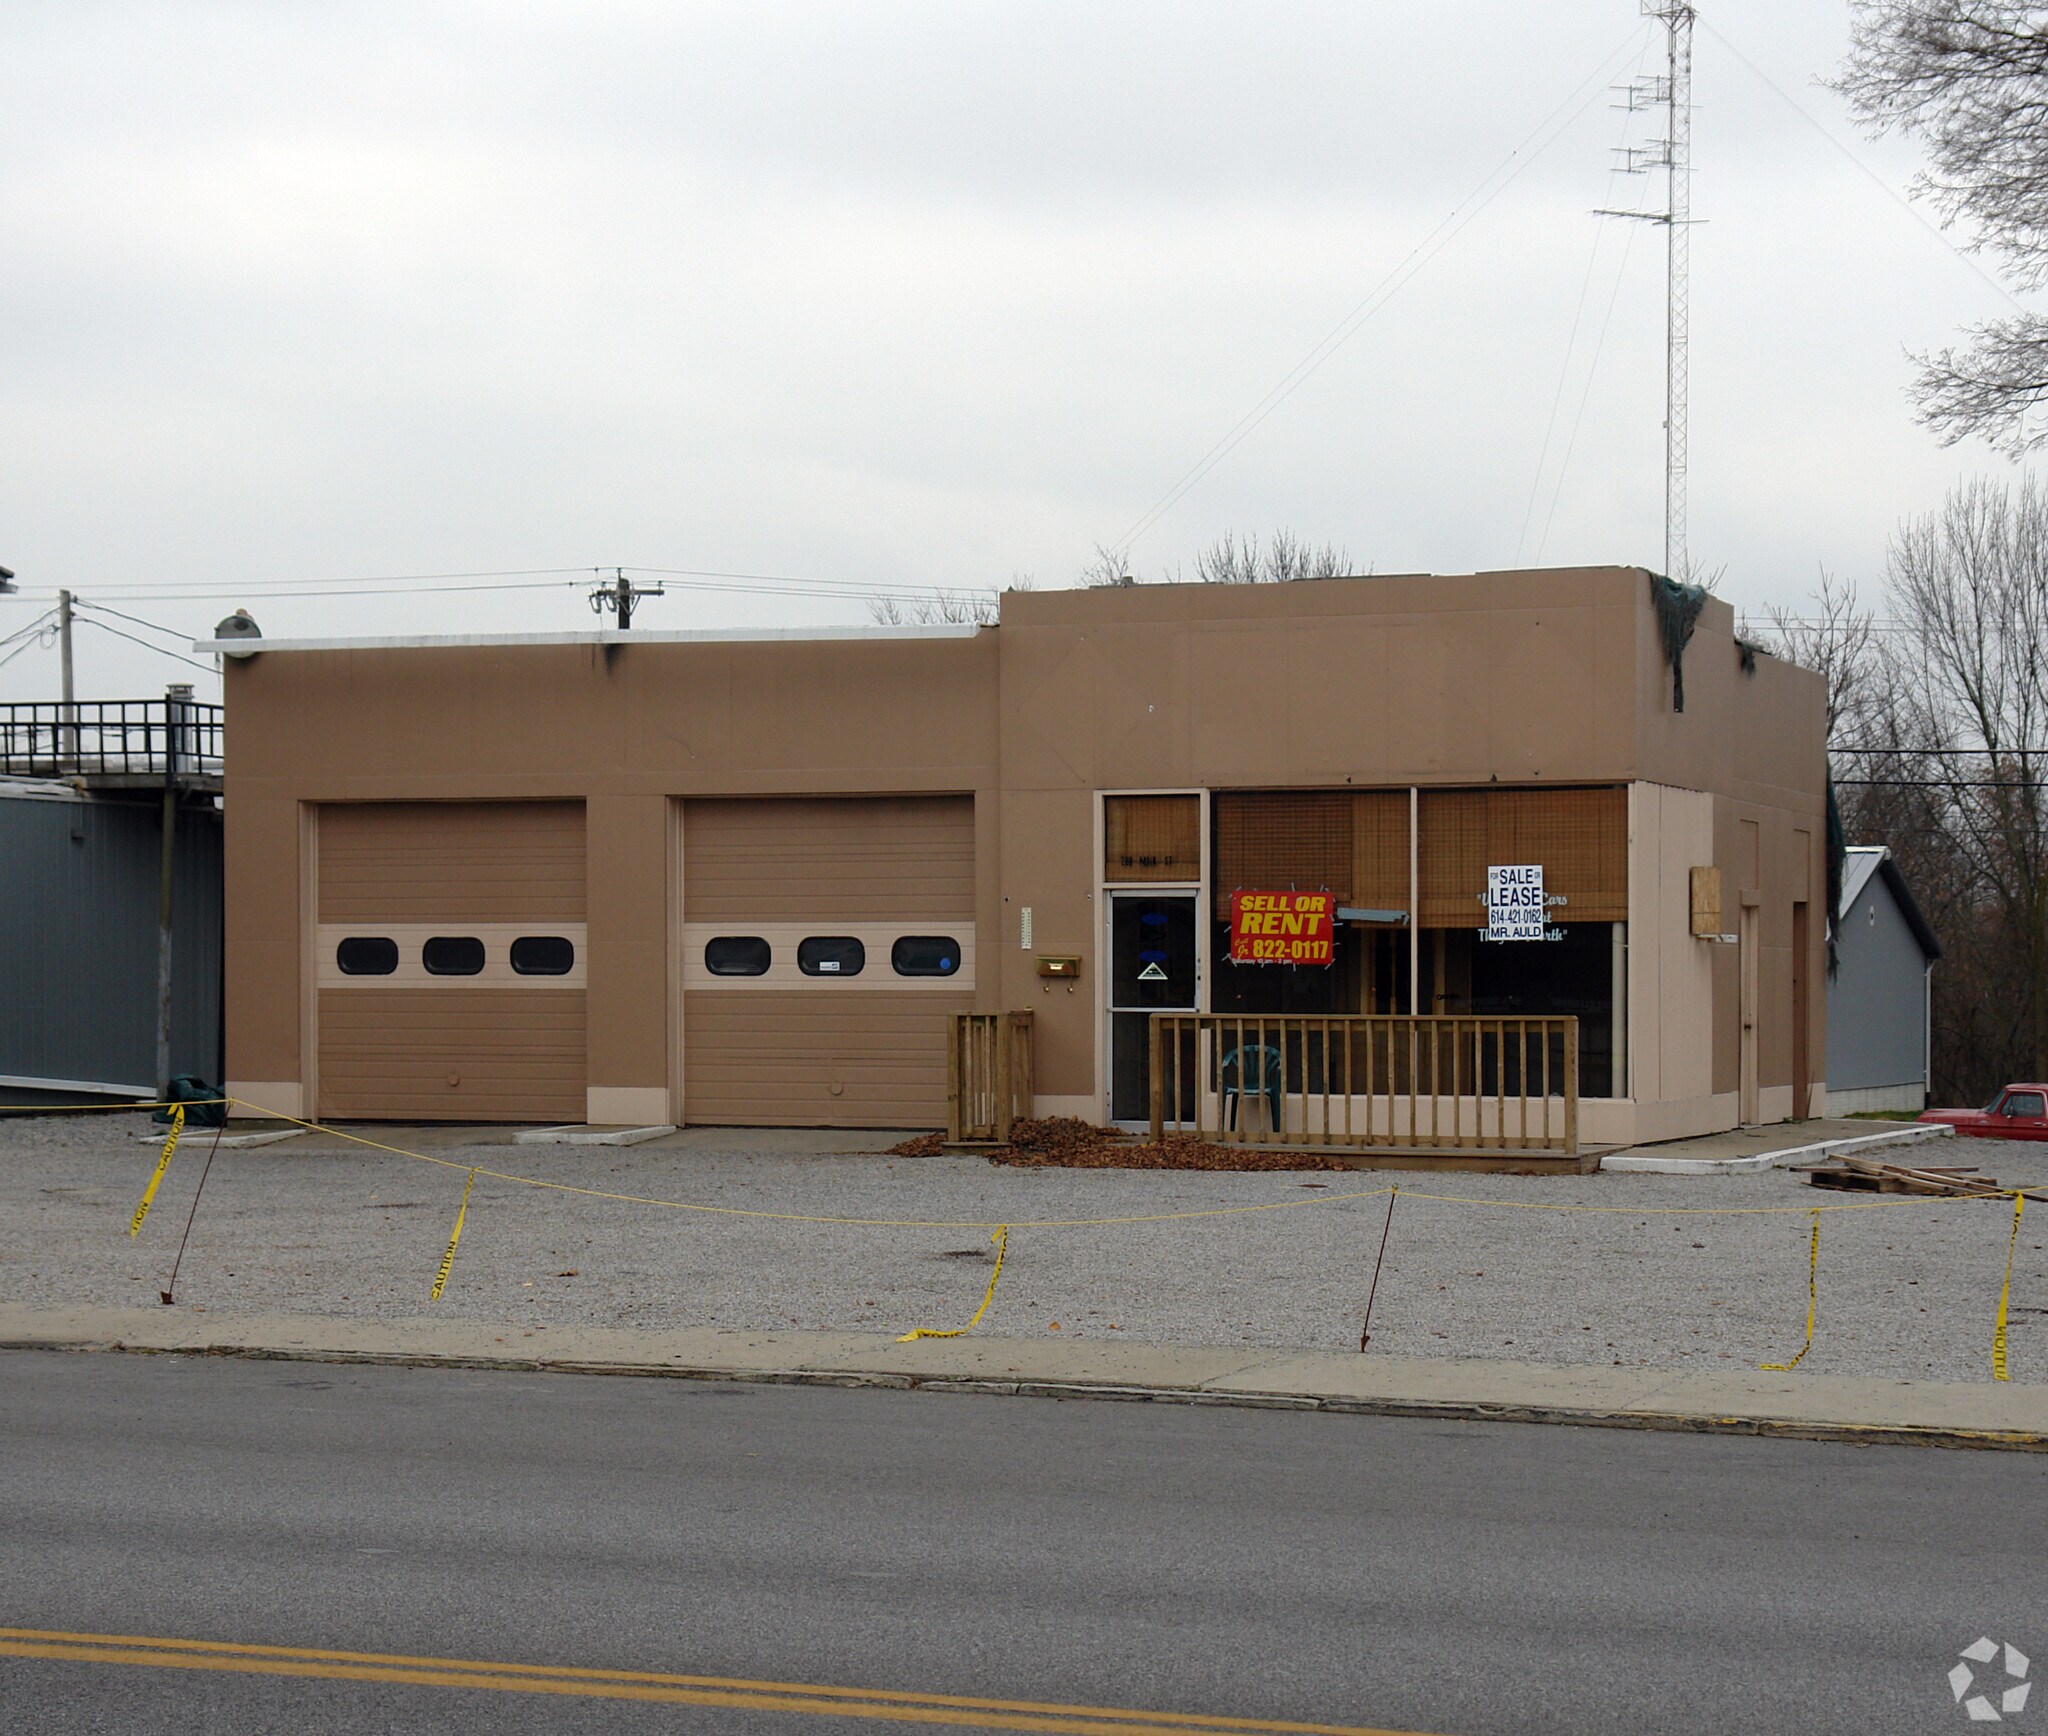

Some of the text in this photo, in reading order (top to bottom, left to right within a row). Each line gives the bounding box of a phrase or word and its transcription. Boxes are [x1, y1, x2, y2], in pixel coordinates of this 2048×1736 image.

[1500, 869, 1533, 884] SALE
[1240, 895, 1326, 912] SELL OR
[1490, 887, 1541, 907] LEASE
[1240, 912, 1325, 935] RENT
[1490, 908, 1541, 924] 614-421-0162
[1491, 927, 1510, 938] MR.
[1513, 926, 1541, 938] AULD
[1252, 939, 1328, 959] 822-0117
[157, 1116, 183, 1171] CAUTION
[431, 1241, 456, 1300] CAUTION
